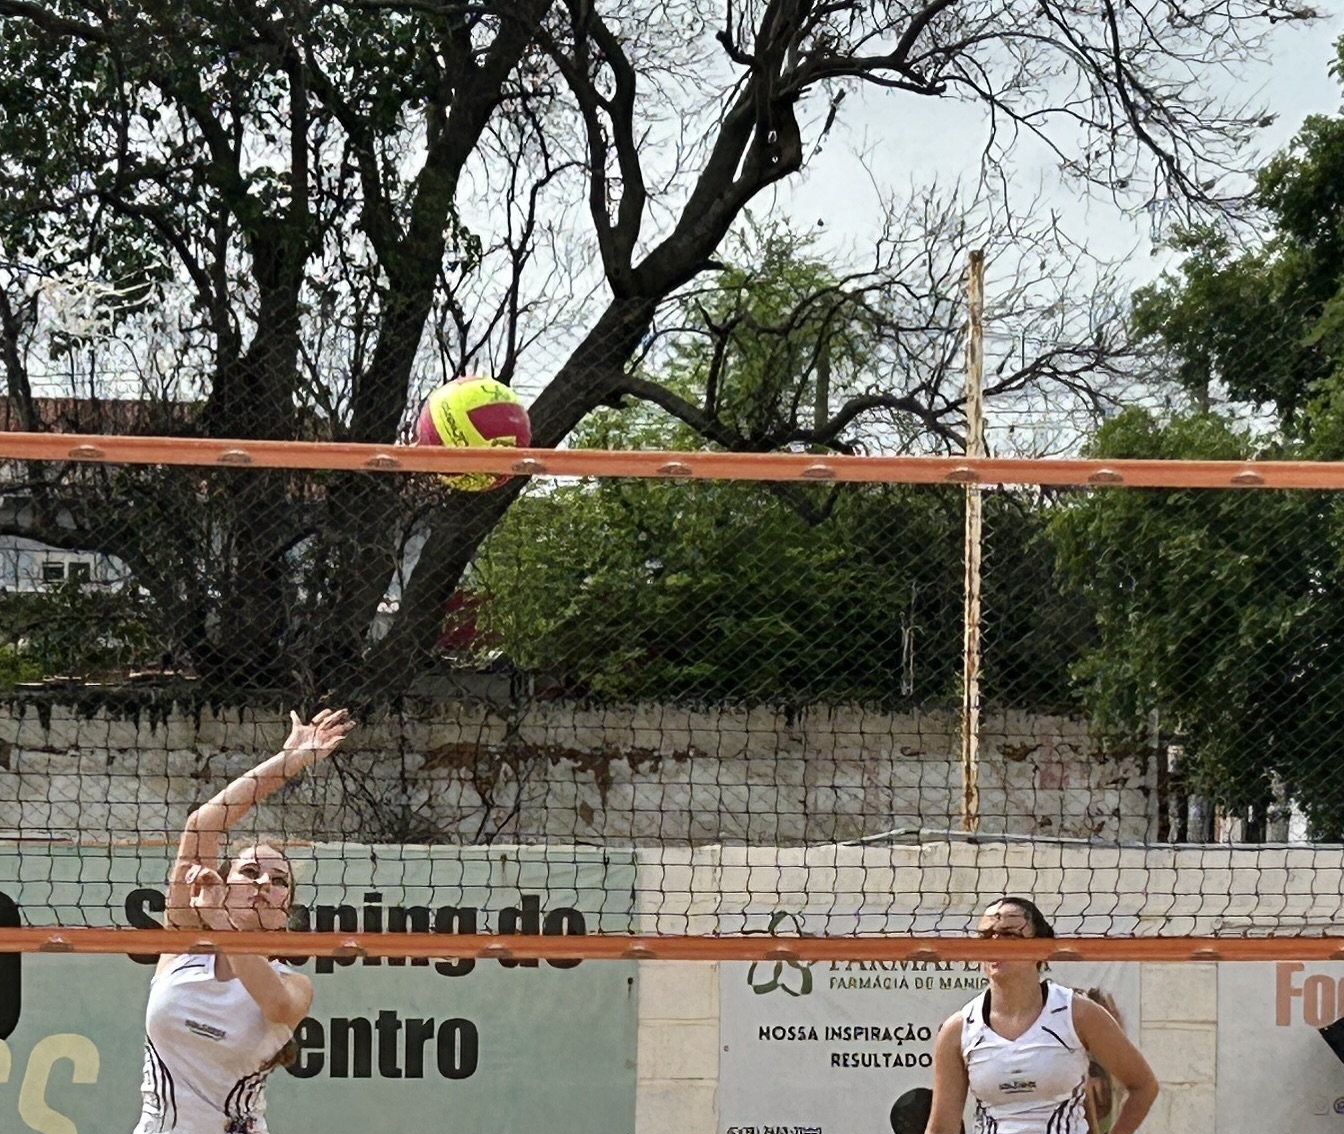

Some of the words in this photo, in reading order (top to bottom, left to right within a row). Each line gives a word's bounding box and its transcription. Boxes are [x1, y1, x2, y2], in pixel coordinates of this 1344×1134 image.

[285, 1010, 479, 1080] entro
[759, 1026, 819, 1041] NOSSA
[825, 1023, 932, 1046] INSPIRAÇÃO
[831, 1053, 933, 1068] RESULTADO
